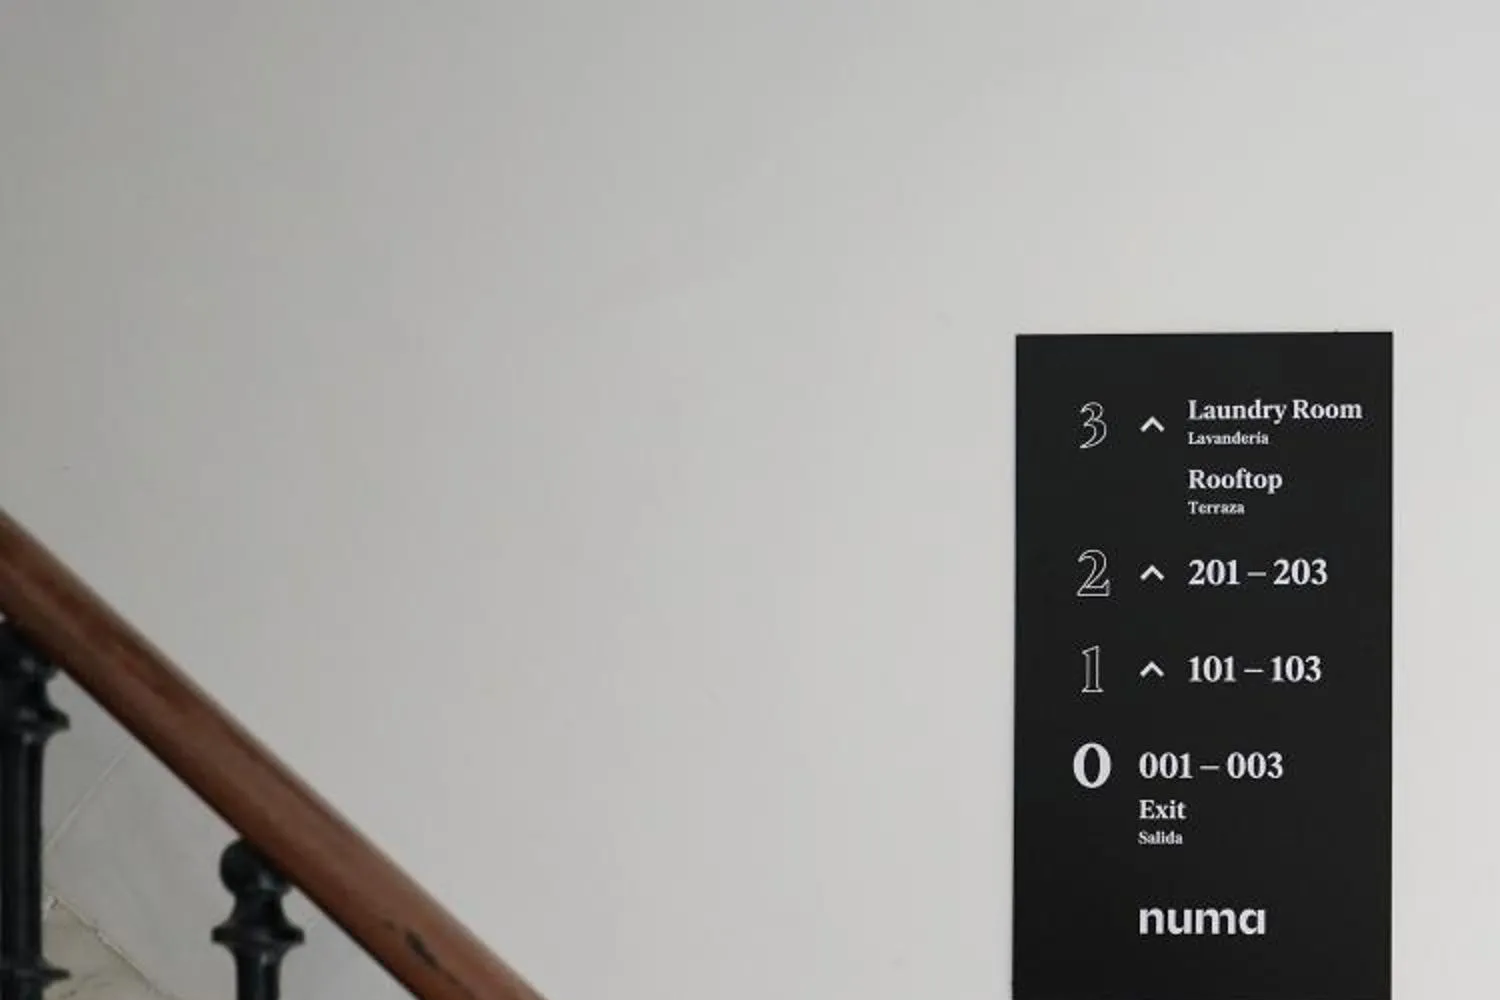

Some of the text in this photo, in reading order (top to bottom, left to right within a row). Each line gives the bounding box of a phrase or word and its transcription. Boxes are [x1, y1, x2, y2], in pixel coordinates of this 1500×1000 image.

[1079, 401, 1108, 449] 3
[1187, 399, 1363, 425] Laundry Room
[1187, 467, 1283, 495] Rooftop
[1187, 501, 1245, 515] Terraza
[1076, 549, 1110, 597] 2
[1187, 559, 1241, 586] 201
[1273, 558, 1329, 586] 203
[1080, 645, 1104, 693] 1
[1188, 655, 1237, 683] 101
[1271, 655, 1322, 683] 103
[1139, 751, 1194, 779] 001
[1226, 751, 1284, 779] 003
[1139, 799, 1187, 820] Exit
[1138, 830, 1183, 845] Salida
[1139, 907, 1266, 935] numa
